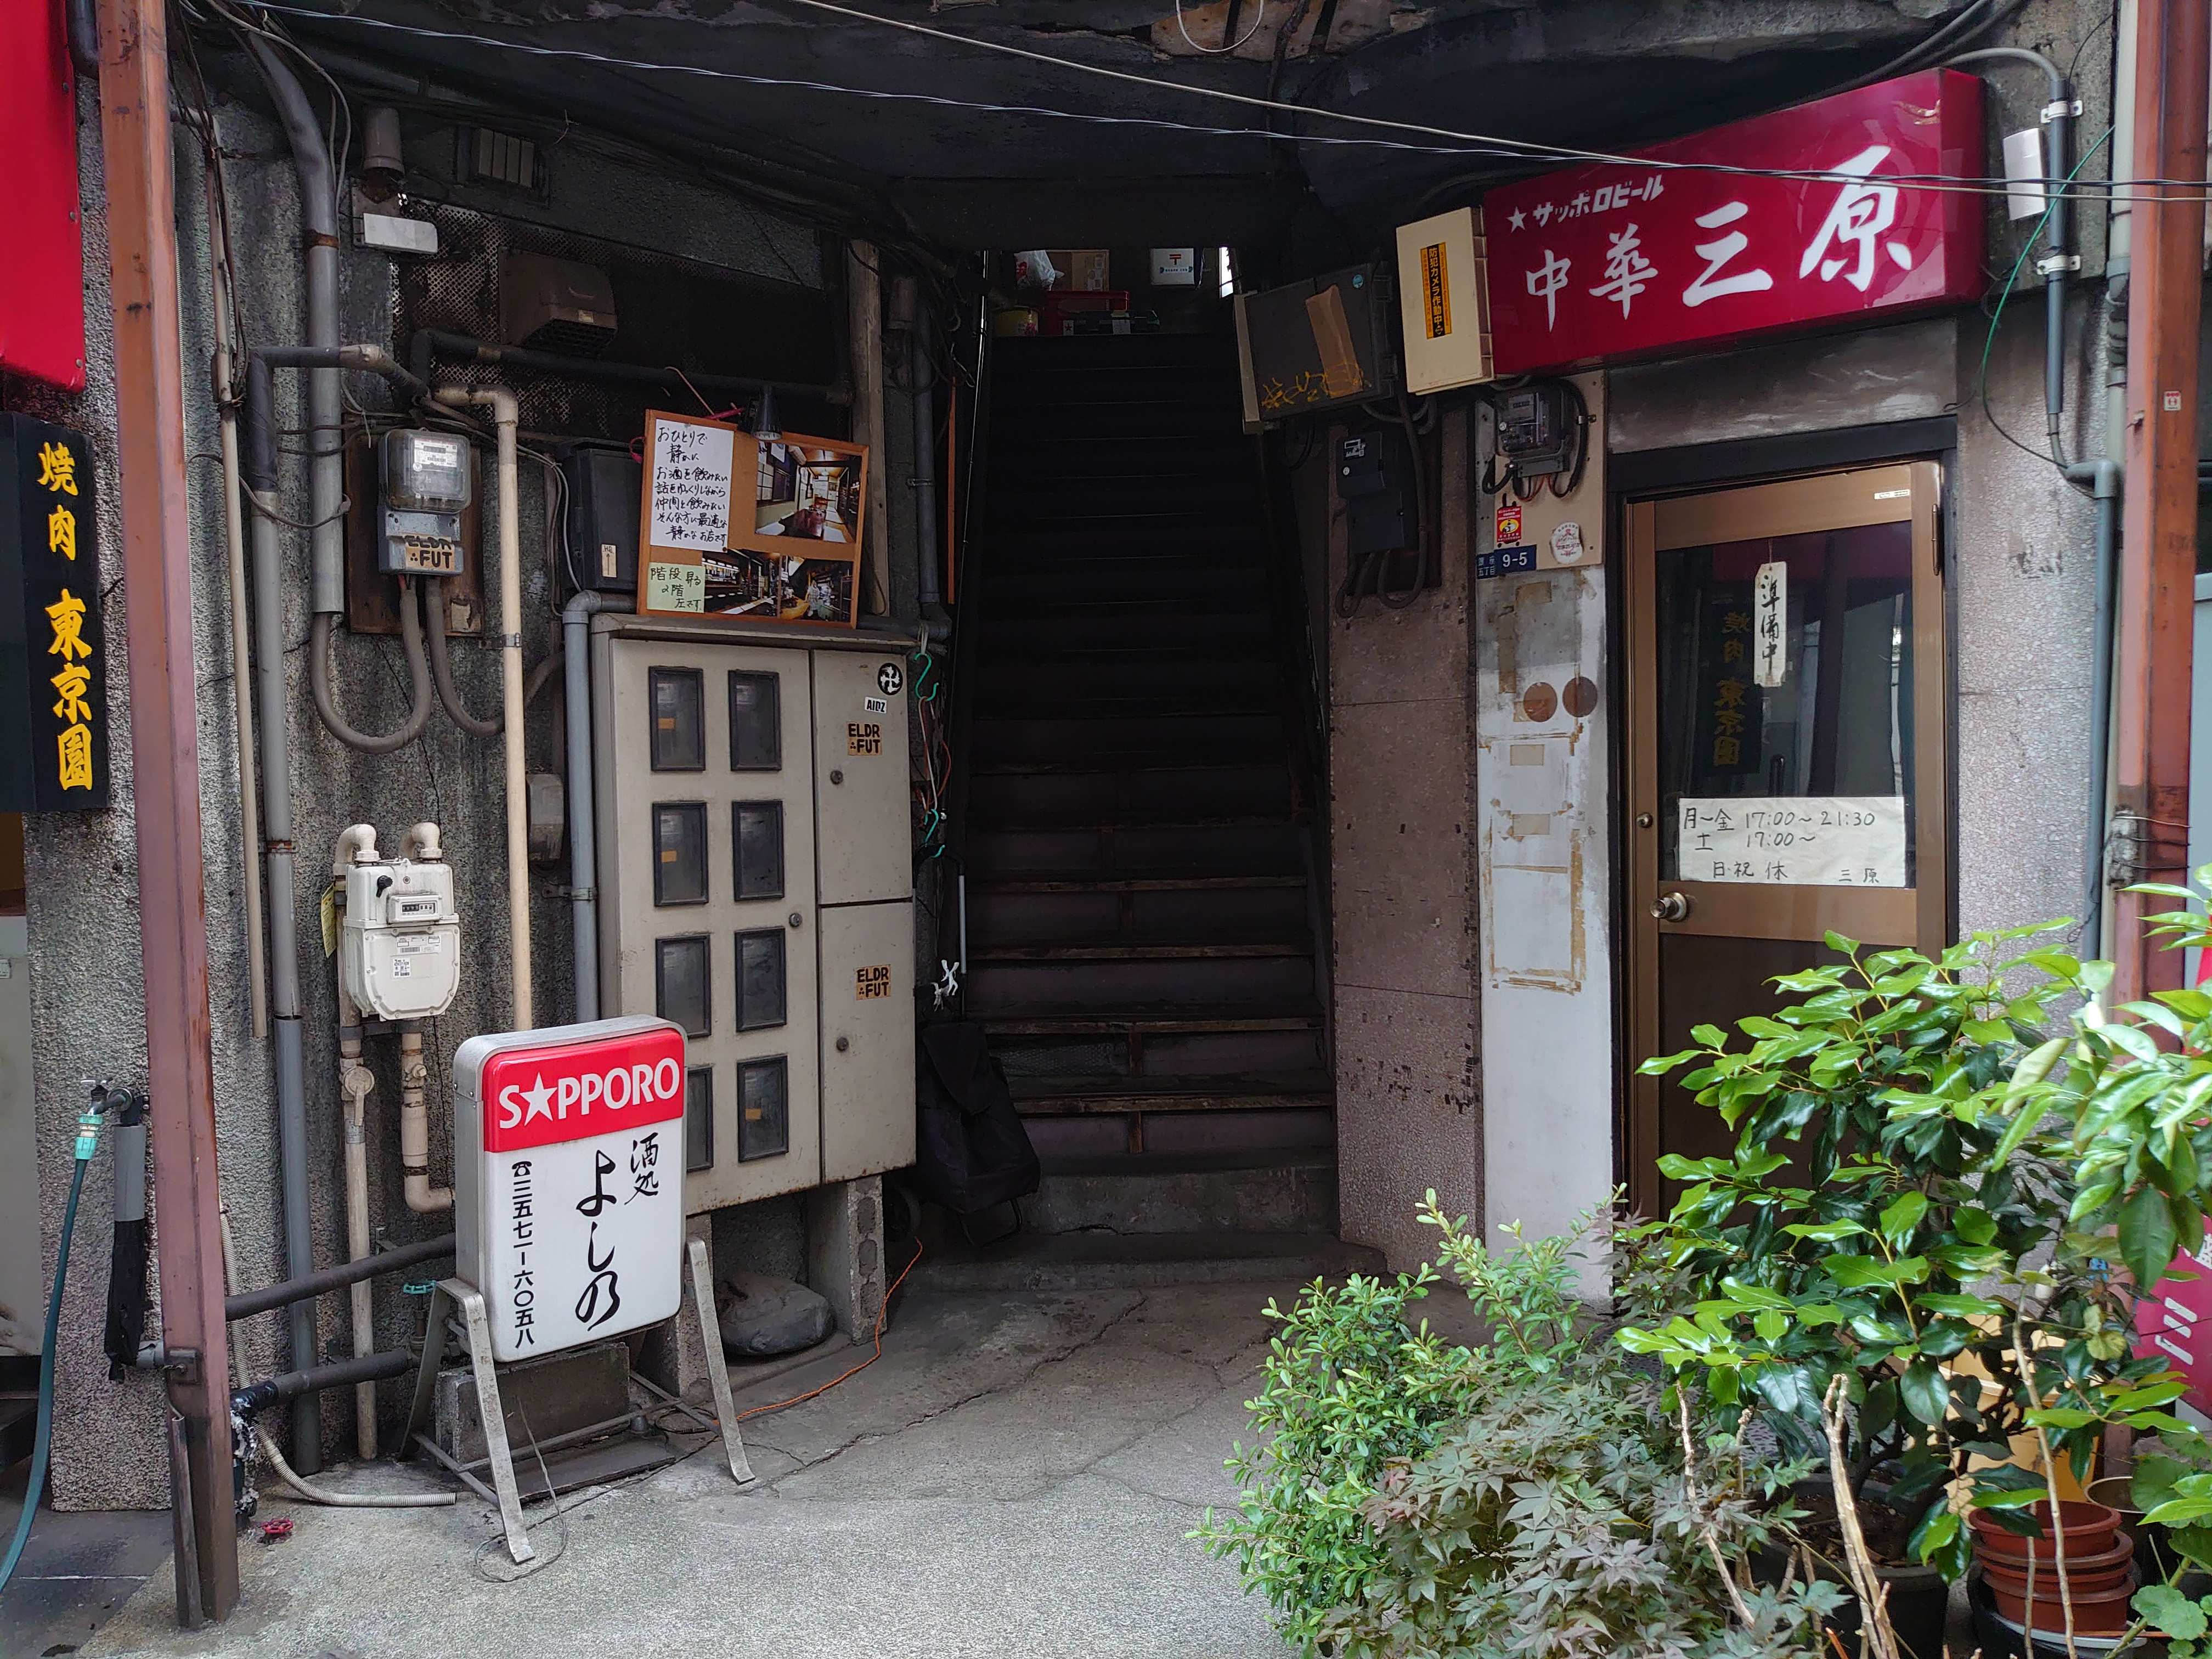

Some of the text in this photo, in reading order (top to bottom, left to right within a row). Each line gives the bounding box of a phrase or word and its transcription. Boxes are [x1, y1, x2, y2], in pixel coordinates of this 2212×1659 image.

[1532, 174, 1664, 227] サッポロビール
[1429, 247, 1442, 325] 防犯カメラ作動中
[657, 427, 708, 448] おひとりで
[666, 443, 699, 464] 静かに
[656, 466, 728, 482] お酒を飲みたい
[654, 496, 726, 511] 仲間と飲みたい
[1502, 552, 1528, 567] 9-5
[37, 442, 93, 791] 焼肉 東京園
[1760, 574, 1780, 676] 準備中
[866, 699, 886, 712] AIDZ
[848, 723, 881, 738] ELDR
[1695, 833, 1713, 850] 土
[856, 967, 889, 983] ELDR
[624, 1132, 659, 1206] 酒処
[575, 1150, 620, 1331] よしの
